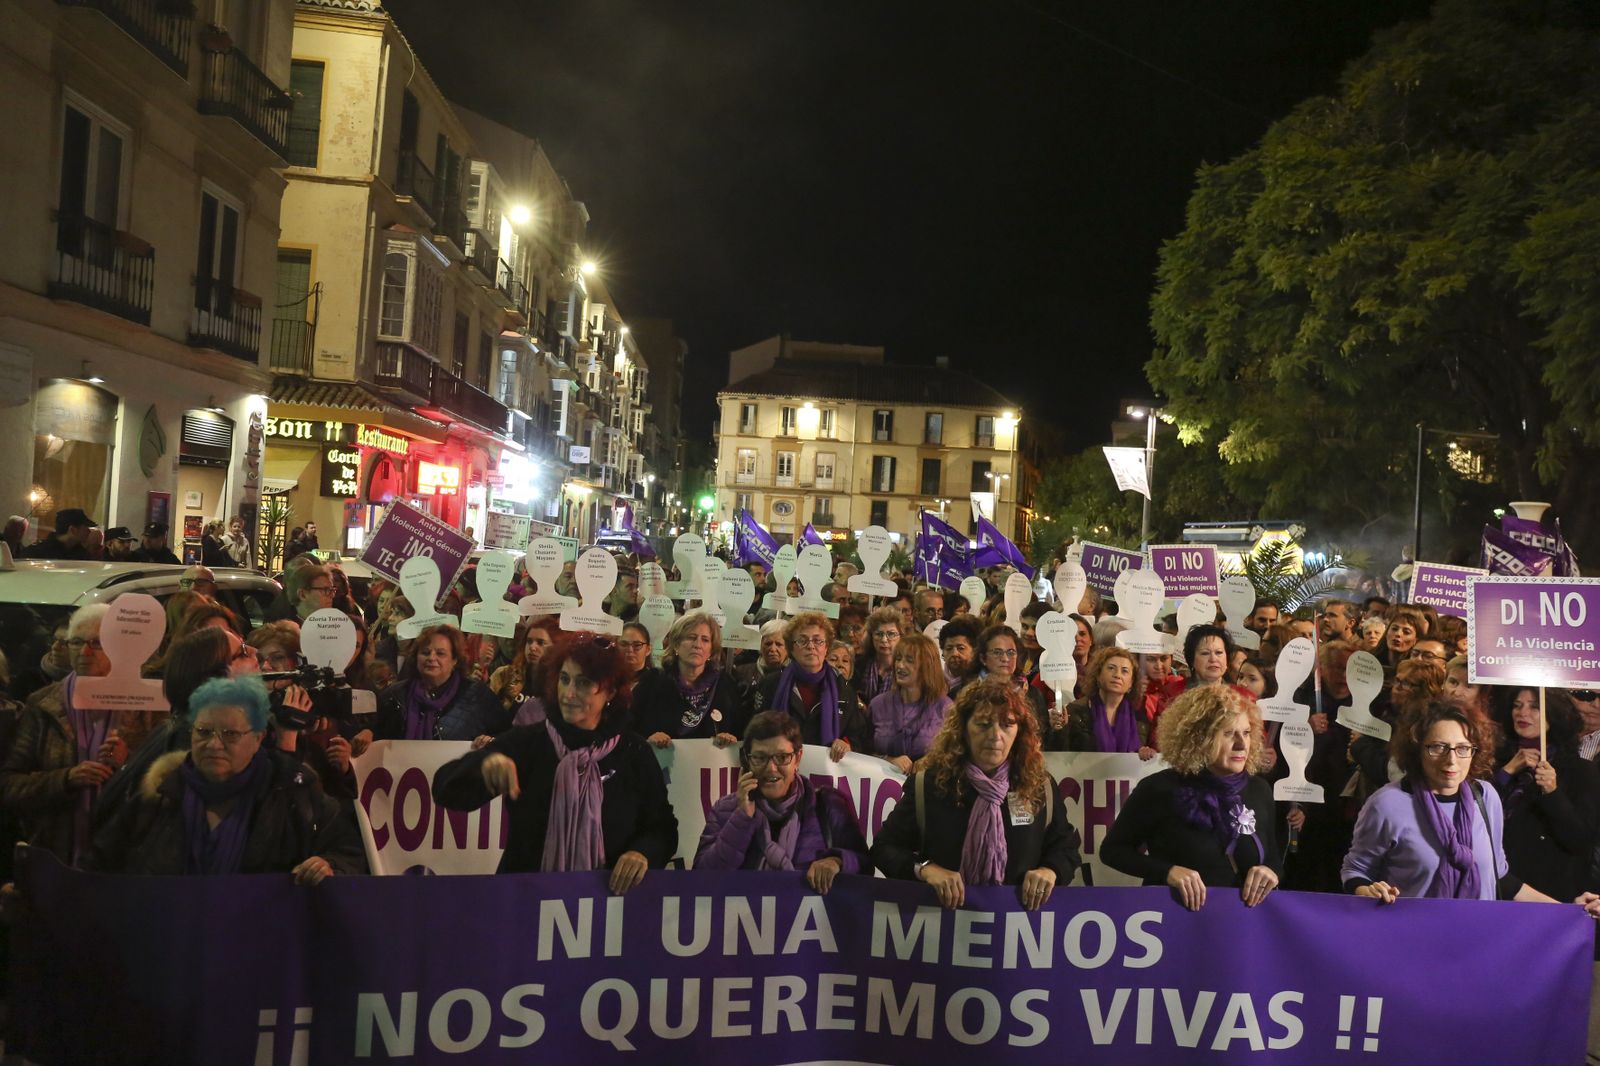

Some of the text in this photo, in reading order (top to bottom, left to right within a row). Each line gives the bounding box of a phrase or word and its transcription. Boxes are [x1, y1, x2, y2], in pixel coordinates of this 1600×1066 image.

[357, 423, 409, 455] Restaurante
[341, 465, 356, 480] de
[391, 514, 462, 559] Violencia de Género
[418, 518, 445, 537] Ante la
[377, 547, 396, 568] TE
[1091, 554, 1130, 573] DI NO
[1164, 551, 1204, 570] DI NO
[1092, 571, 1099, 579] la
[1100, 575, 1115, 584] Viole
[1098, 583, 1108, 591] las
[1421, 574, 1466, 586] El Silenc
[1178, 583, 1189, 591] las
[1189, 583, 1217, 592] mujeres
[1426, 587, 1443, 595] NOS
[1501, 591, 1587, 627] DI NO
[1495, 636, 1595, 651] A la Violencia
[537, 895, 1164, 969] NI UNA MENOS
[354, 983, 546, 1057] NOS
[579, 973, 1052, 1051] QUEREMOS
[1079, 987, 1304, 1051] VIVAS
[1335, 995, 1383, 1052] !!
